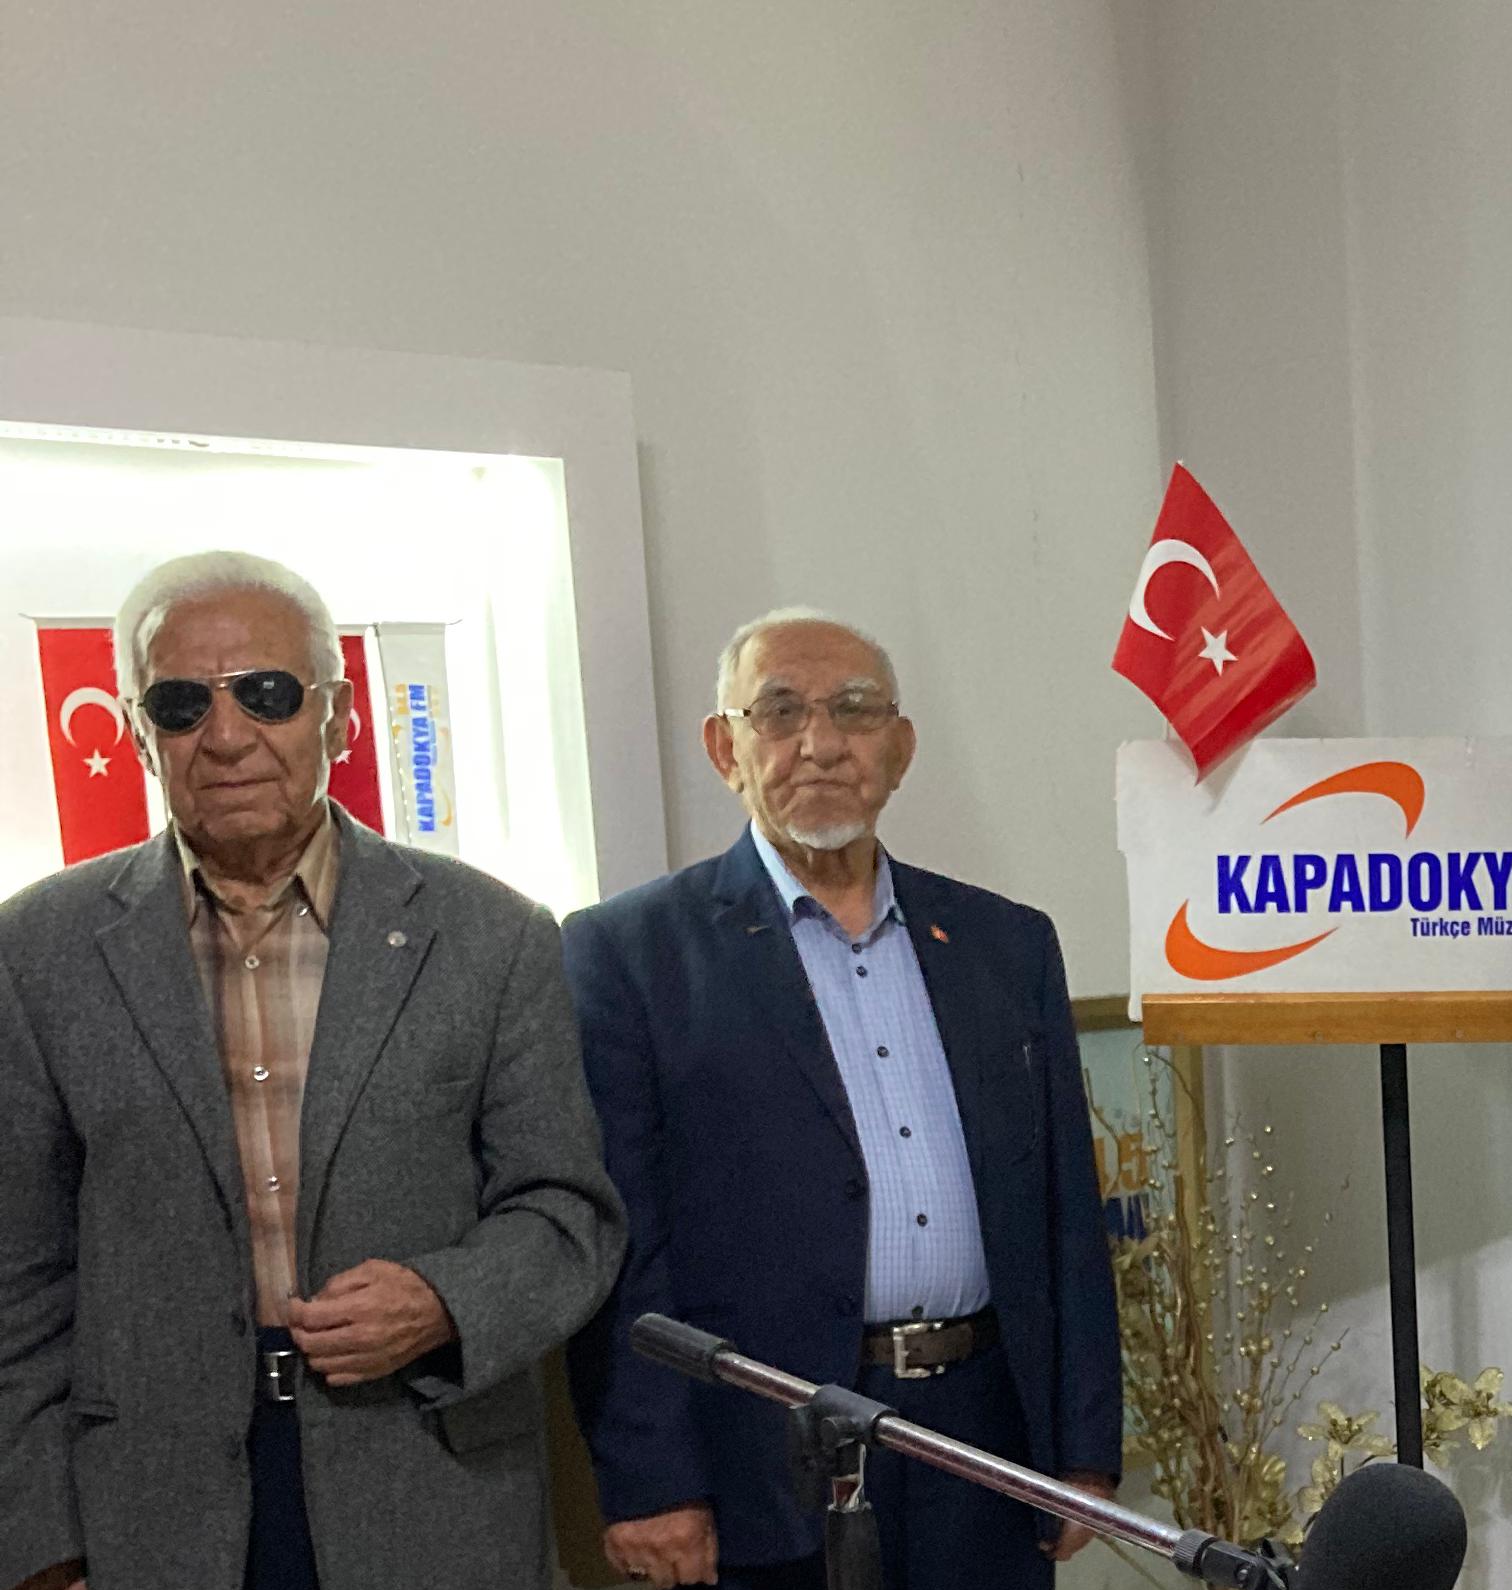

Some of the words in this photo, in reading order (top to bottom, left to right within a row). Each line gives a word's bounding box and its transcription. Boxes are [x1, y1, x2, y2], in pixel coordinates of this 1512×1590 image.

[408, 684, 427, 711] FM
[411, 717, 435, 832] KAPADOKYA
[1410, 917, 1471, 939] Türkçe
